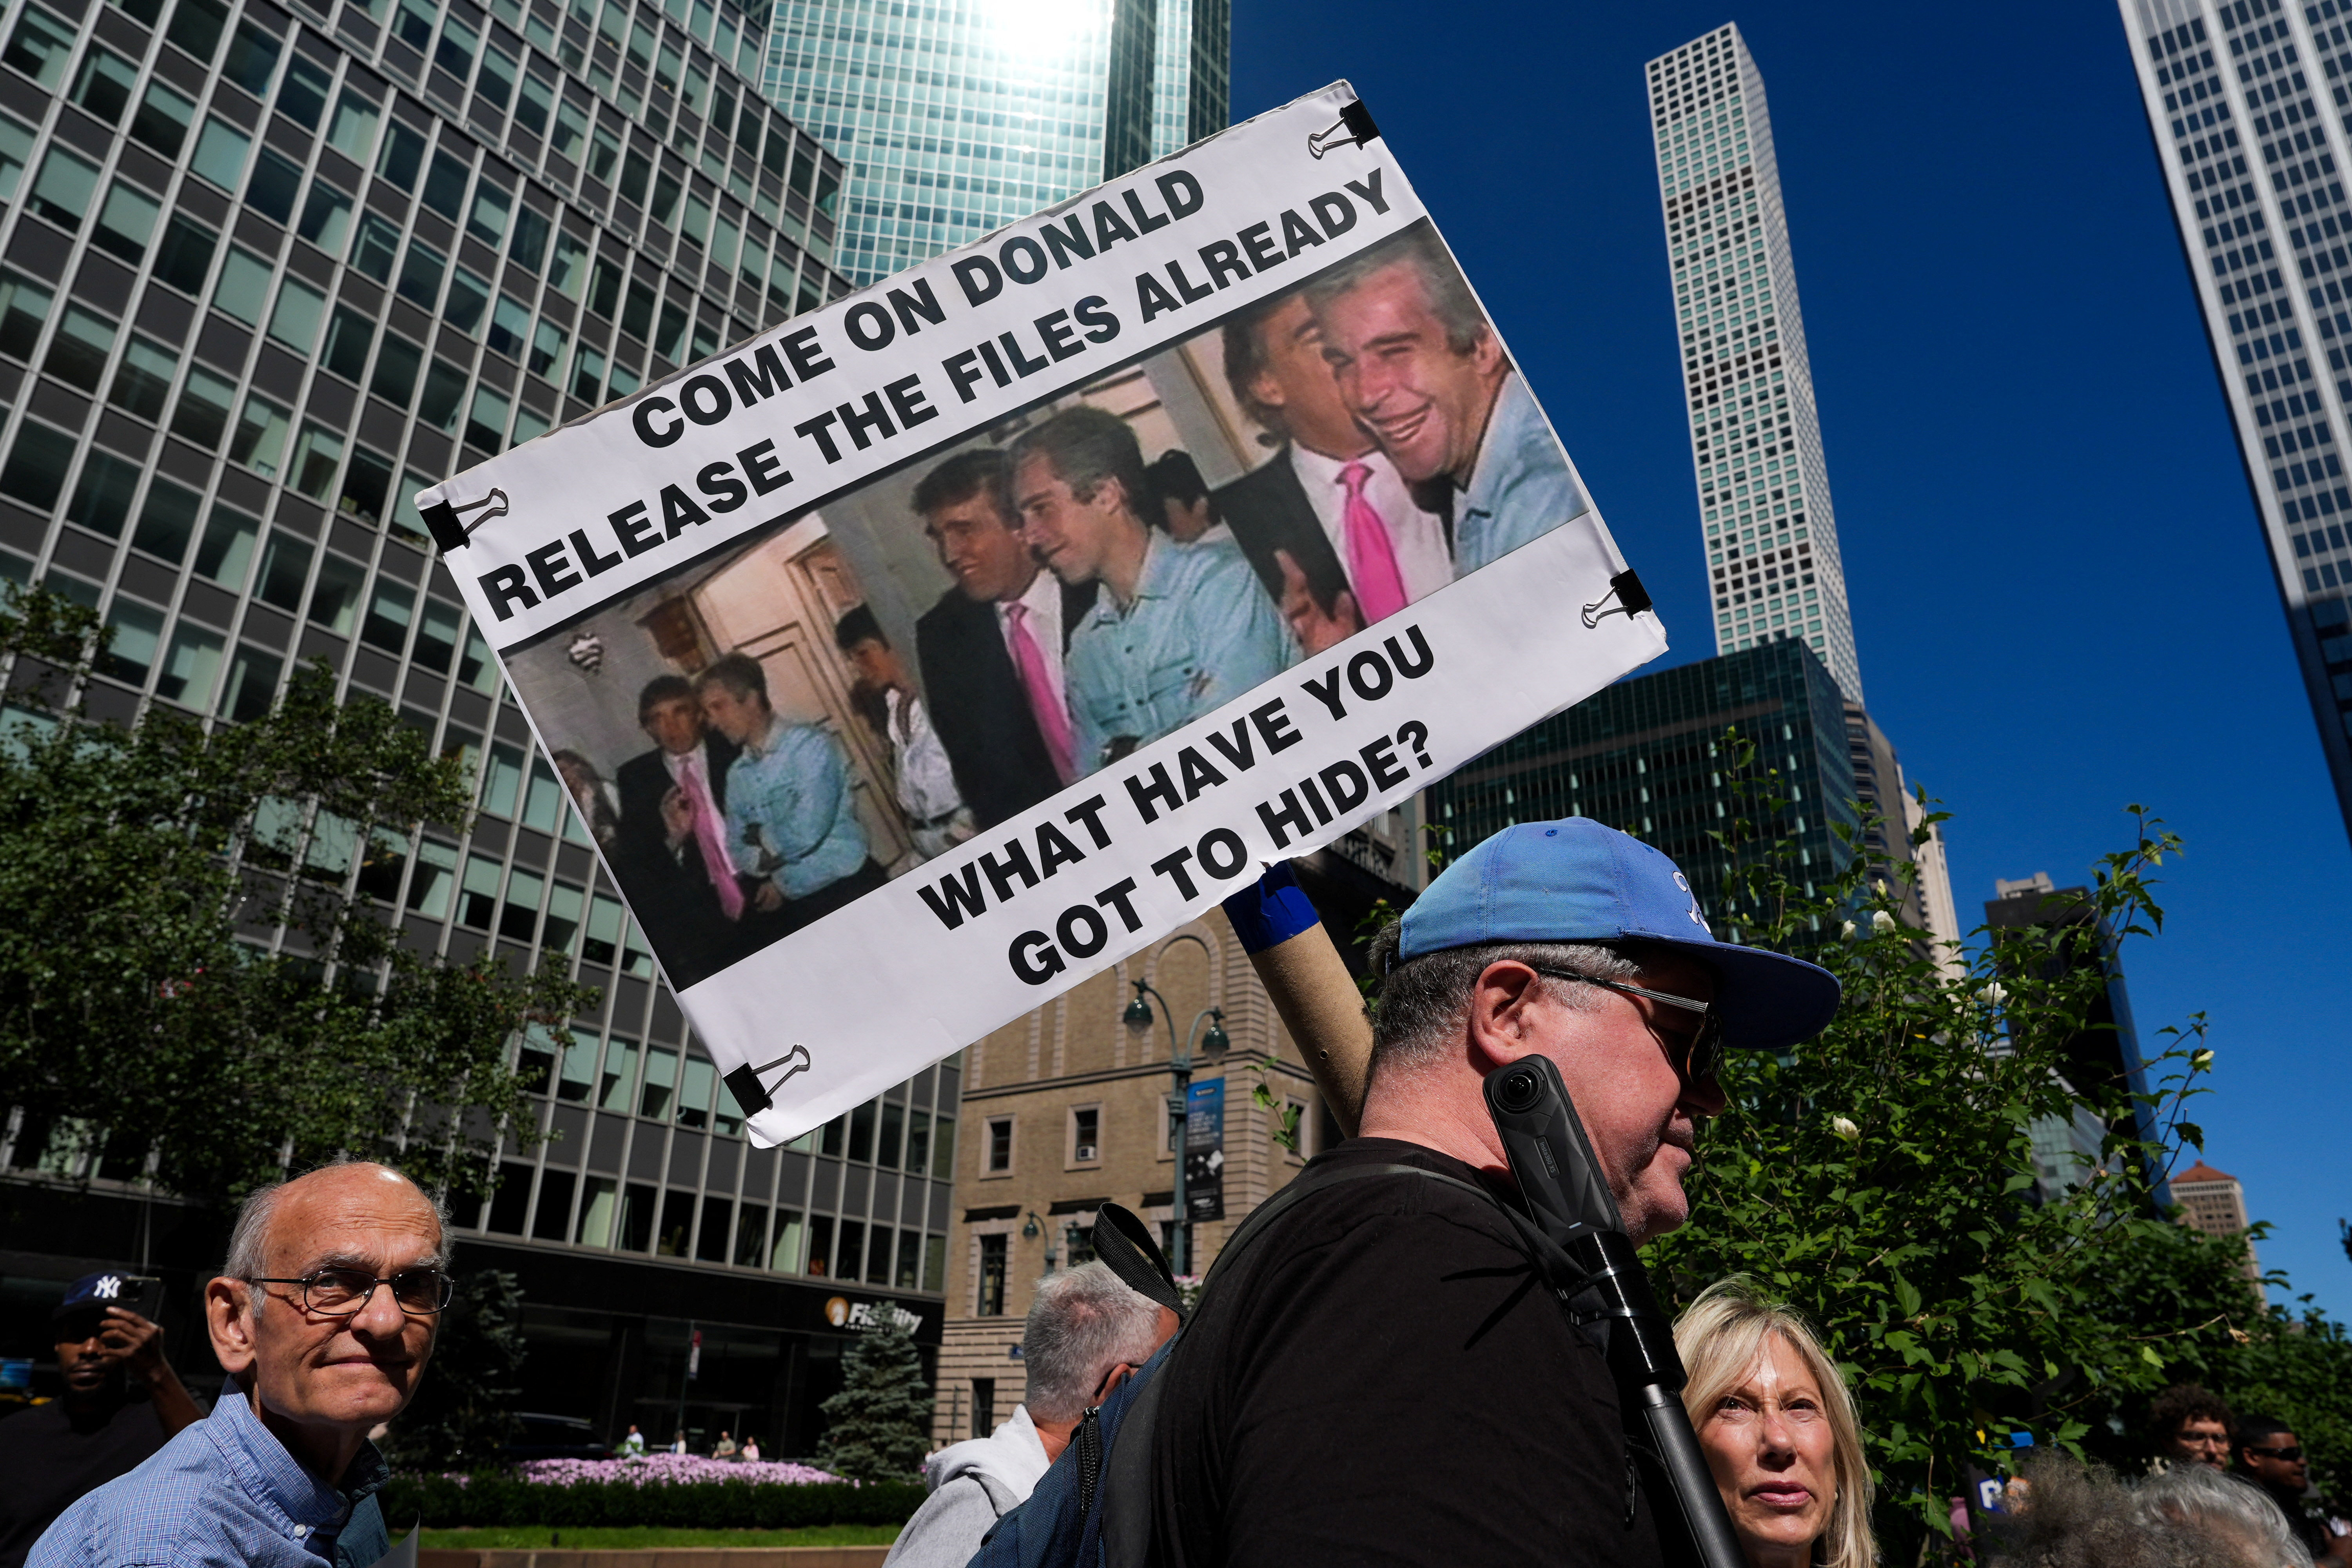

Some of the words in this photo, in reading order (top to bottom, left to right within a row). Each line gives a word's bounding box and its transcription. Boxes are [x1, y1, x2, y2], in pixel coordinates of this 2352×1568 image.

[477, 438, 793, 622] RELEASE
[794, 373, 939, 465] THE
[942, 296, 1120, 404] FILES
[1136, 167, 1390, 324] ALREADY
[633, 325, 836, 448] COME
[844, 278, 946, 351] ON
[951, 170, 1203, 308] DONALD
[916, 794, 1112, 930] WHAT
[1123, 697, 1303, 824] HAVE
[1300, 624, 1434, 721] YOU
[1009, 877, 1143, 985] GOT
[1151, 828, 1247, 902] TO
[1255, 720, 1433, 850] HIDE?
[94, 1276, 121, 1298] NY
[1539, 1142, 1553, 1165] Insta360
[1549, 1165, 1556, 1173] X5
